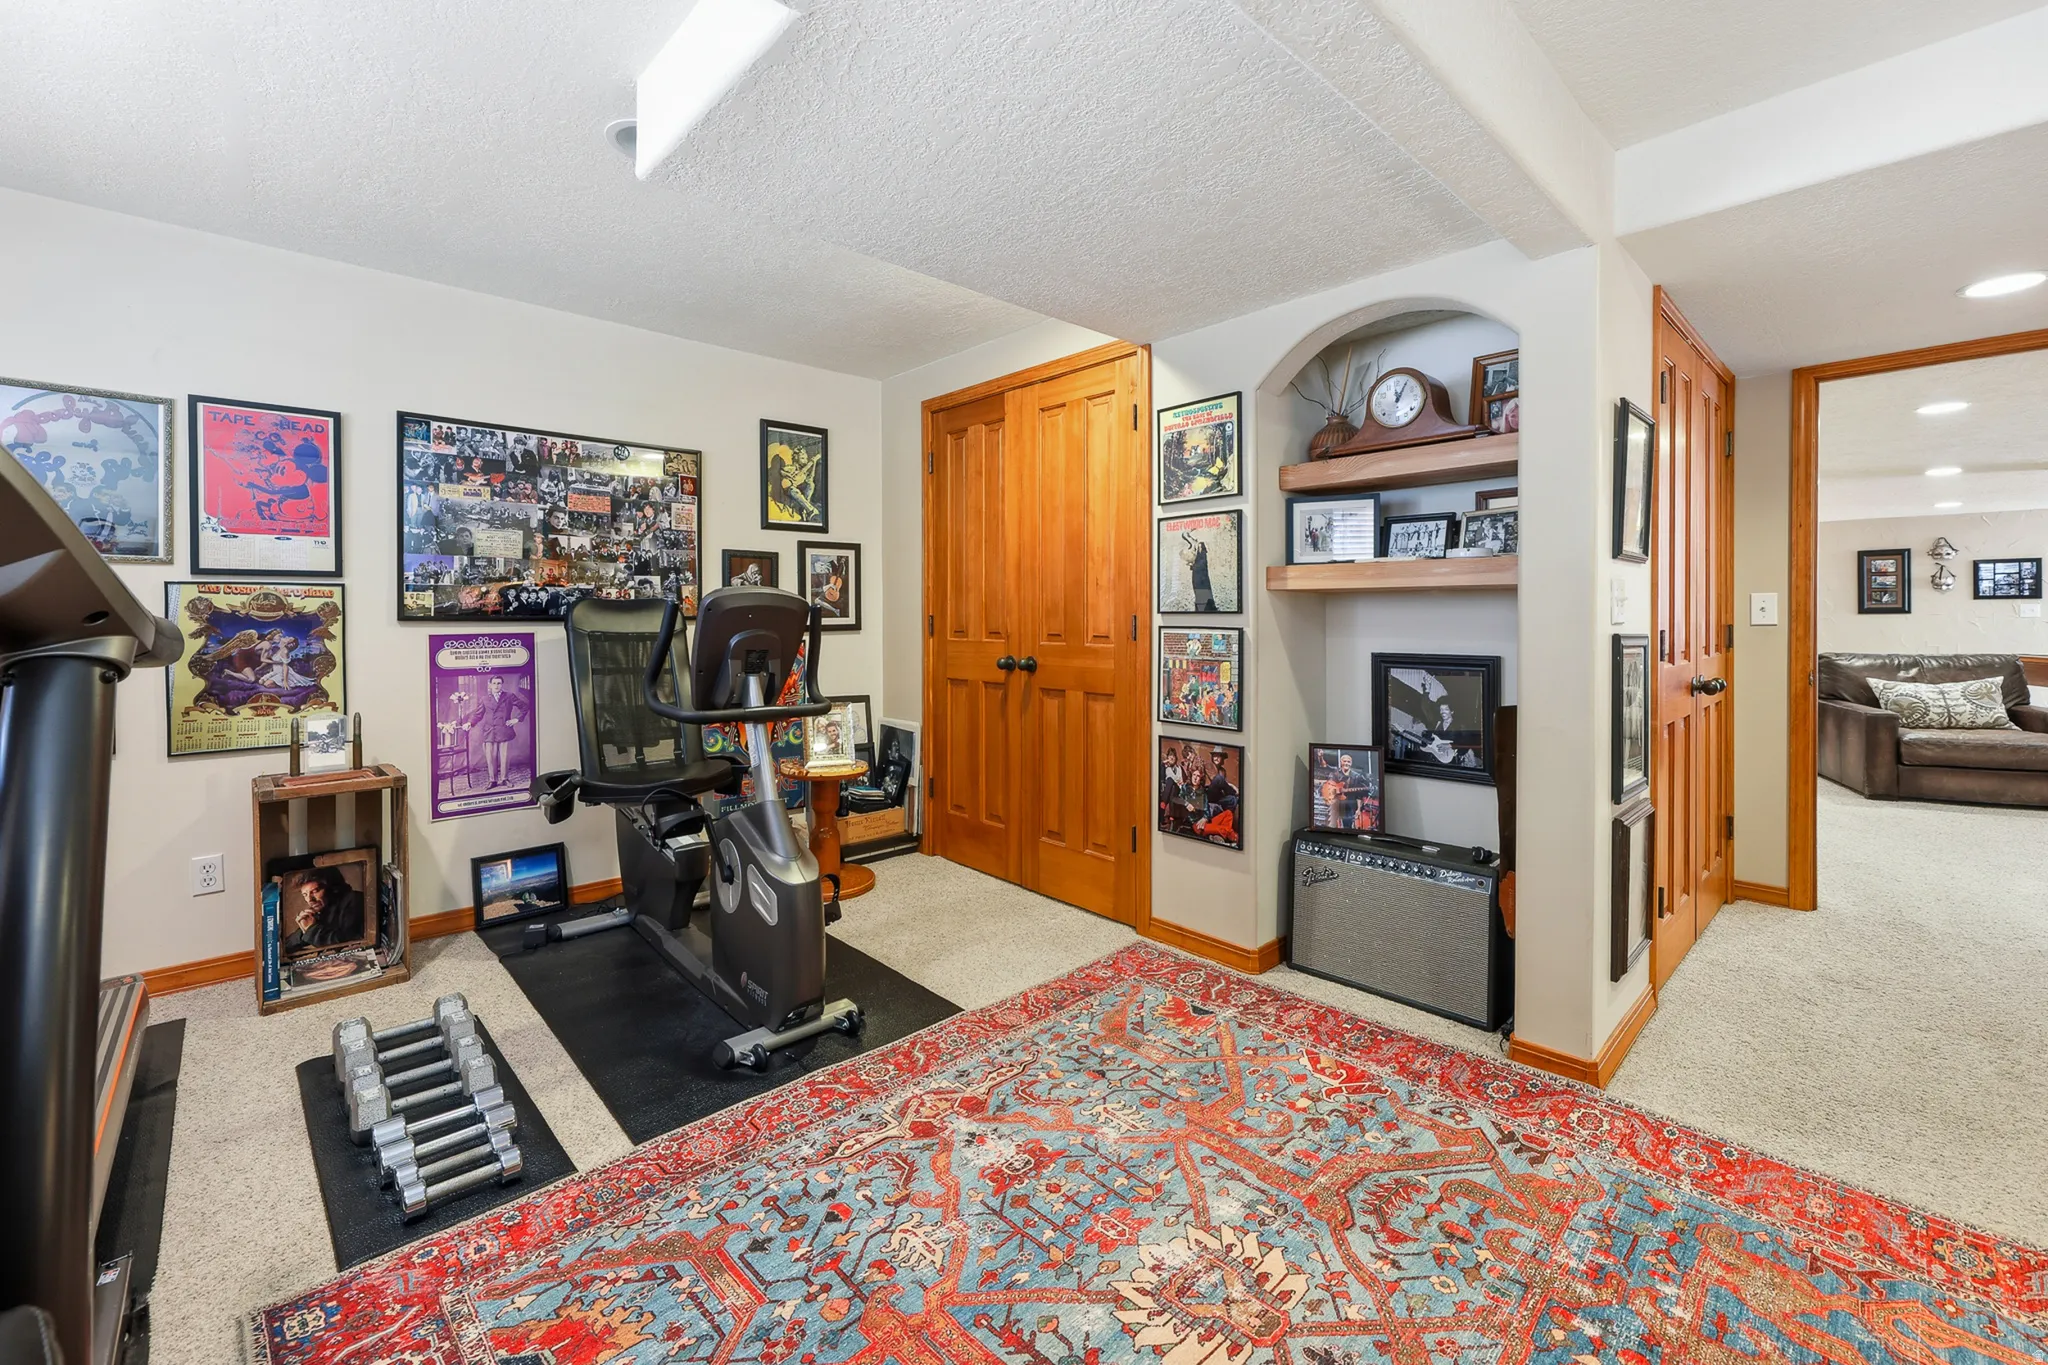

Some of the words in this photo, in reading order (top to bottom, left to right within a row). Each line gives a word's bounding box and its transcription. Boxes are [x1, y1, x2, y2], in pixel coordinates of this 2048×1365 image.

[208, 411, 255, 426] TAPE
[280, 420, 325, 434] HEAD
[275, 586, 335, 600] eroplane
